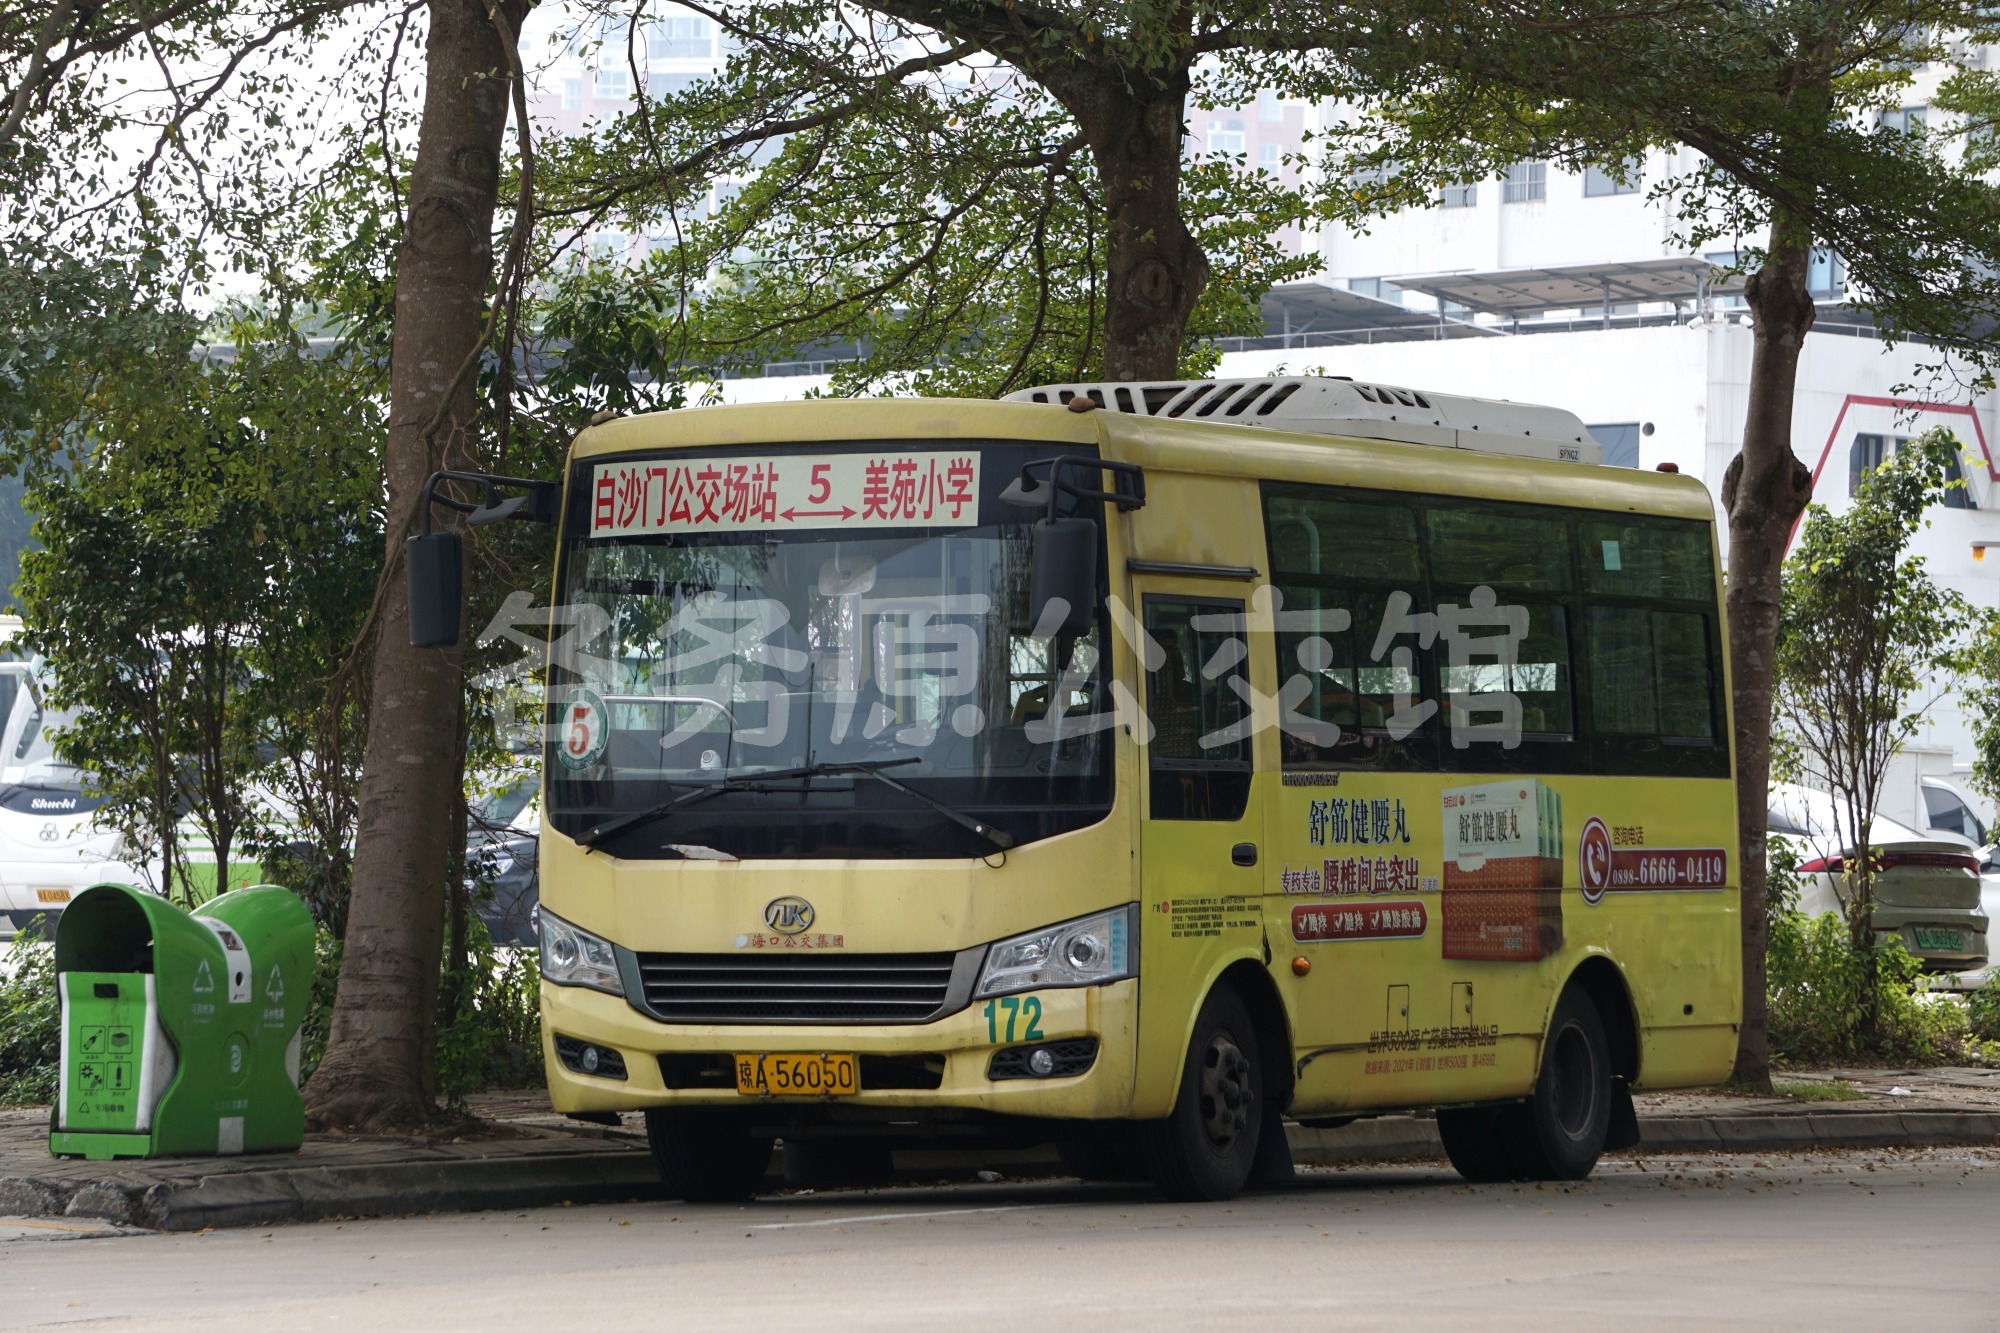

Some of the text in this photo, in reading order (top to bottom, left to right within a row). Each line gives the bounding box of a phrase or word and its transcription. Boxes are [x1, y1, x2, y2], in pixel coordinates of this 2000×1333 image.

[595, 458, 974, 530] 白沙门公交场站 5 美苑小学
[568, 707, 591, 756] 5
[31, 798, 76, 809] Shuchi
[1309, 797, 1411, 846] 舒筋健腰丸
[1459, 808, 1521, 844] 舒筋健腰丸
[1612, 826, 1644, 845] 咨询电话
[1281, 864, 1321, 893] 专药专治
[1323, 854, 1419, 894] 腰椎间盘突出
[1613, 857, 1722, 885] 0898-6666-0419
[752, 934, 844, 948] 海口公交集团
[983, 996, 1044, 1043] 172
